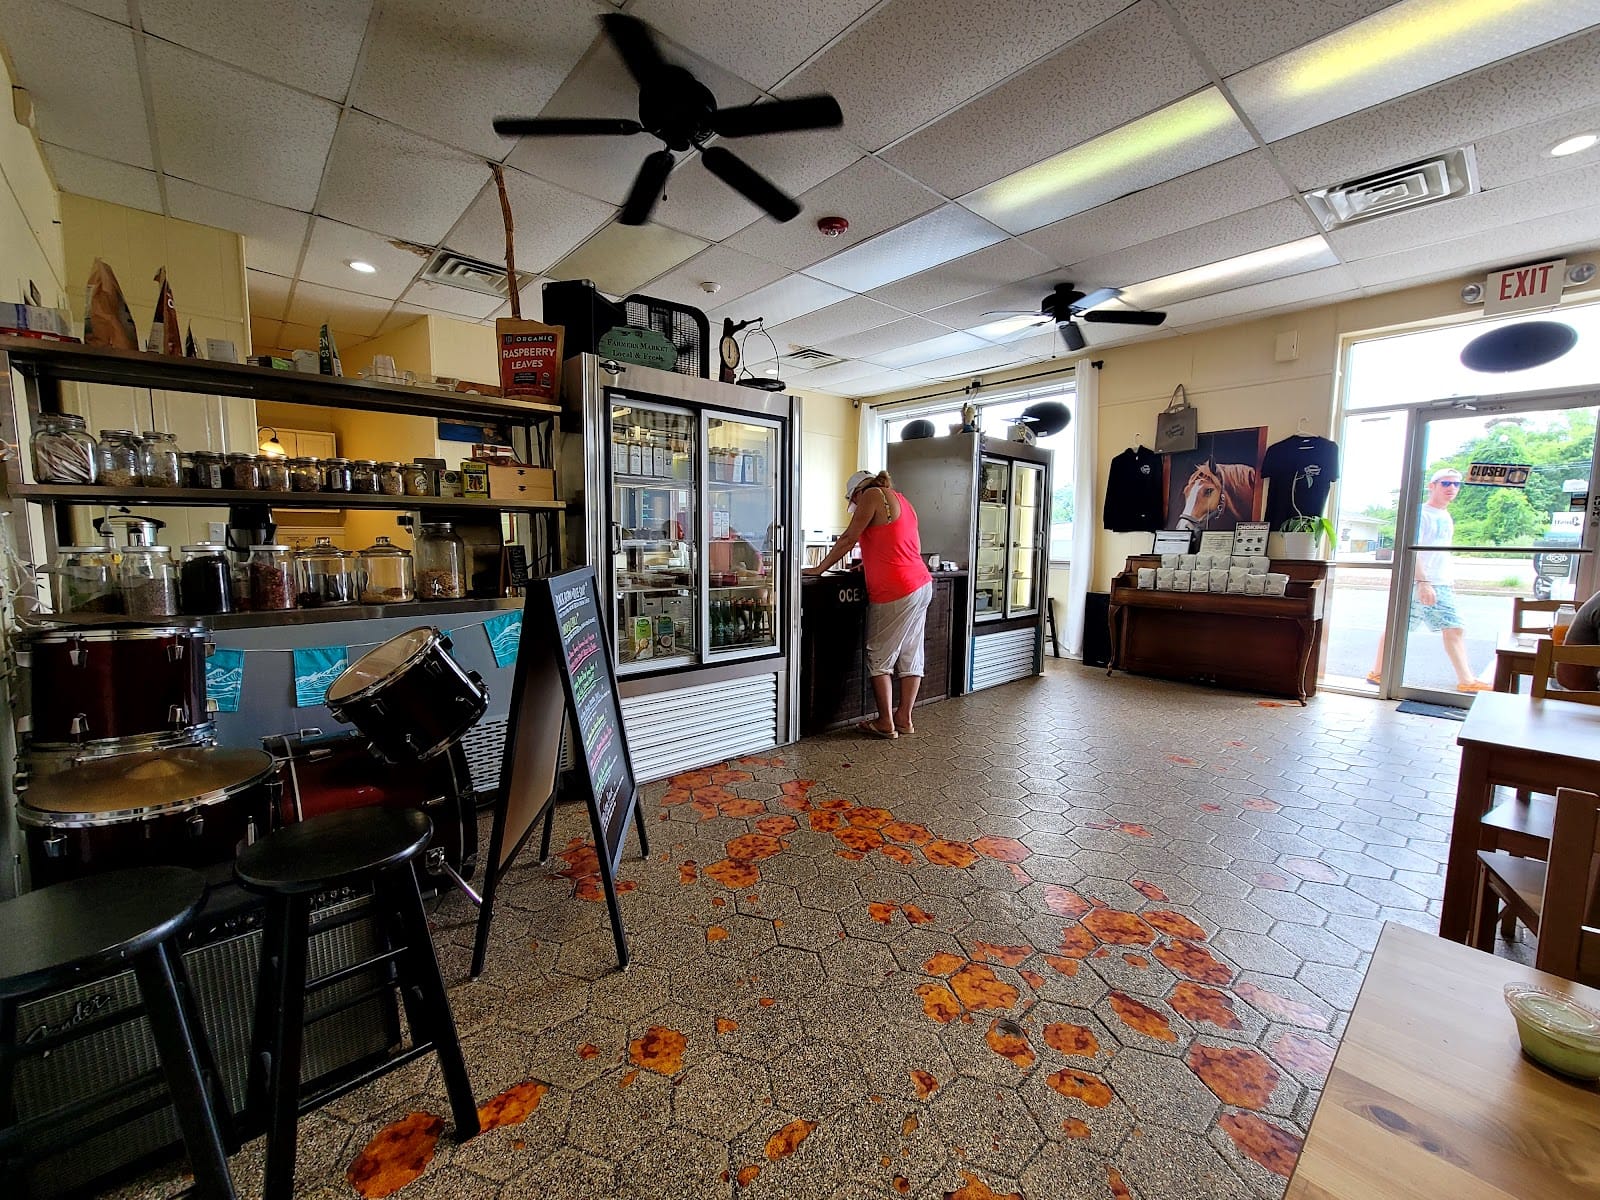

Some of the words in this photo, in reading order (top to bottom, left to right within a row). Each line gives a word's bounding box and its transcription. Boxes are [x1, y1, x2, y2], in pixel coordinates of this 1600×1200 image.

[1500, 265, 1553, 300] EXIT
[607, 339, 638, 349] FARMERS
[640, 342, 668, 352] MARKET
[502, 347, 555, 359] RASPBERRY
[612, 350, 632, 358] Local
[643, 353, 664, 361] Fresh
[511, 359, 544, 369] LEAVES
[1470, 465, 1507, 477] CLOSED
